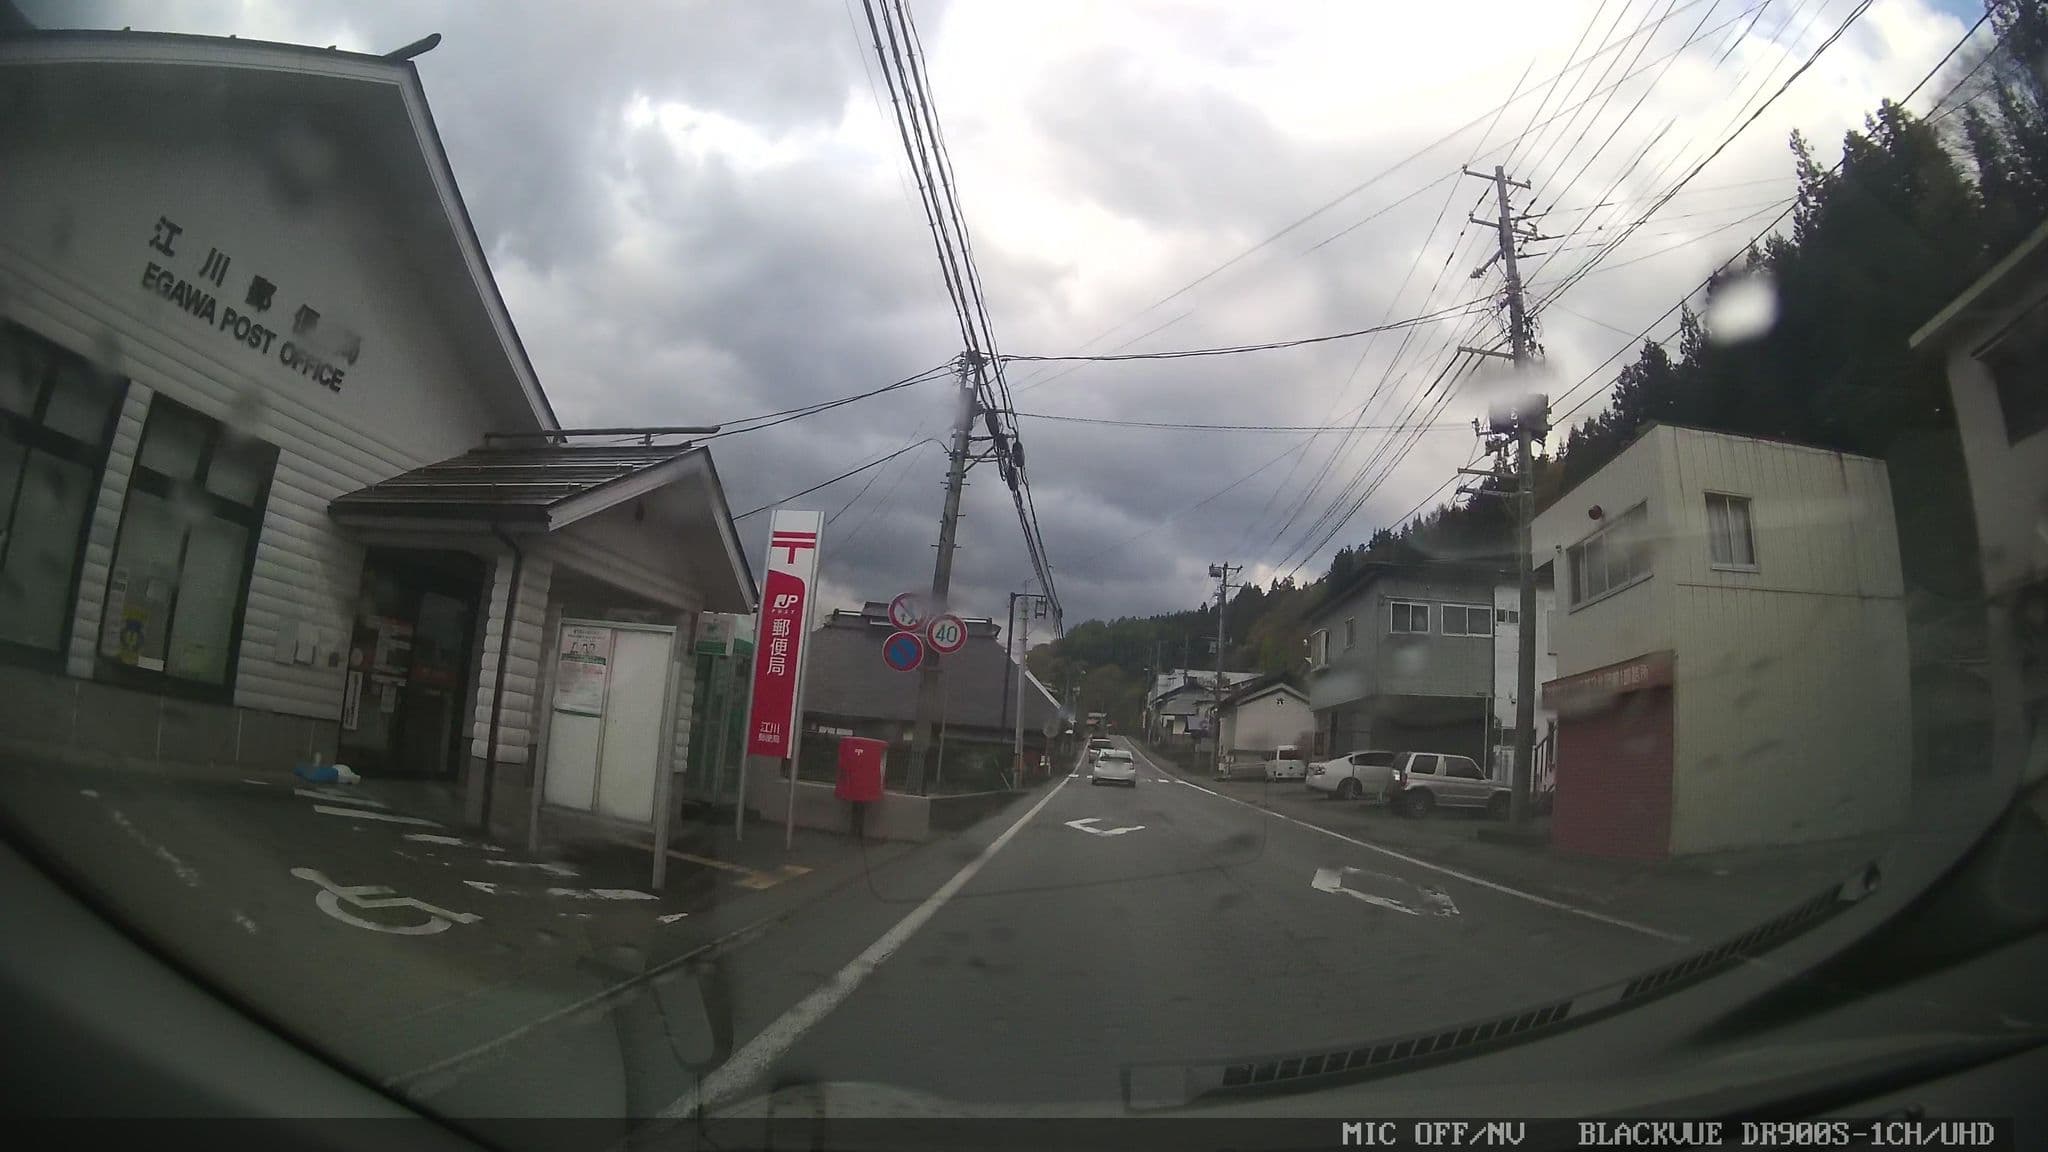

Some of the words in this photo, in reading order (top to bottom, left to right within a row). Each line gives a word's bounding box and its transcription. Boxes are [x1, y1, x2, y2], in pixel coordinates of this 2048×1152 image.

[142, 262, 216, 325] EGAWA
[220, 307, 277, 354] POST
[767, 618, 790, 676] 郵便局
[935, 624, 957, 643] 40
[760, 721, 780, 734] 江川
